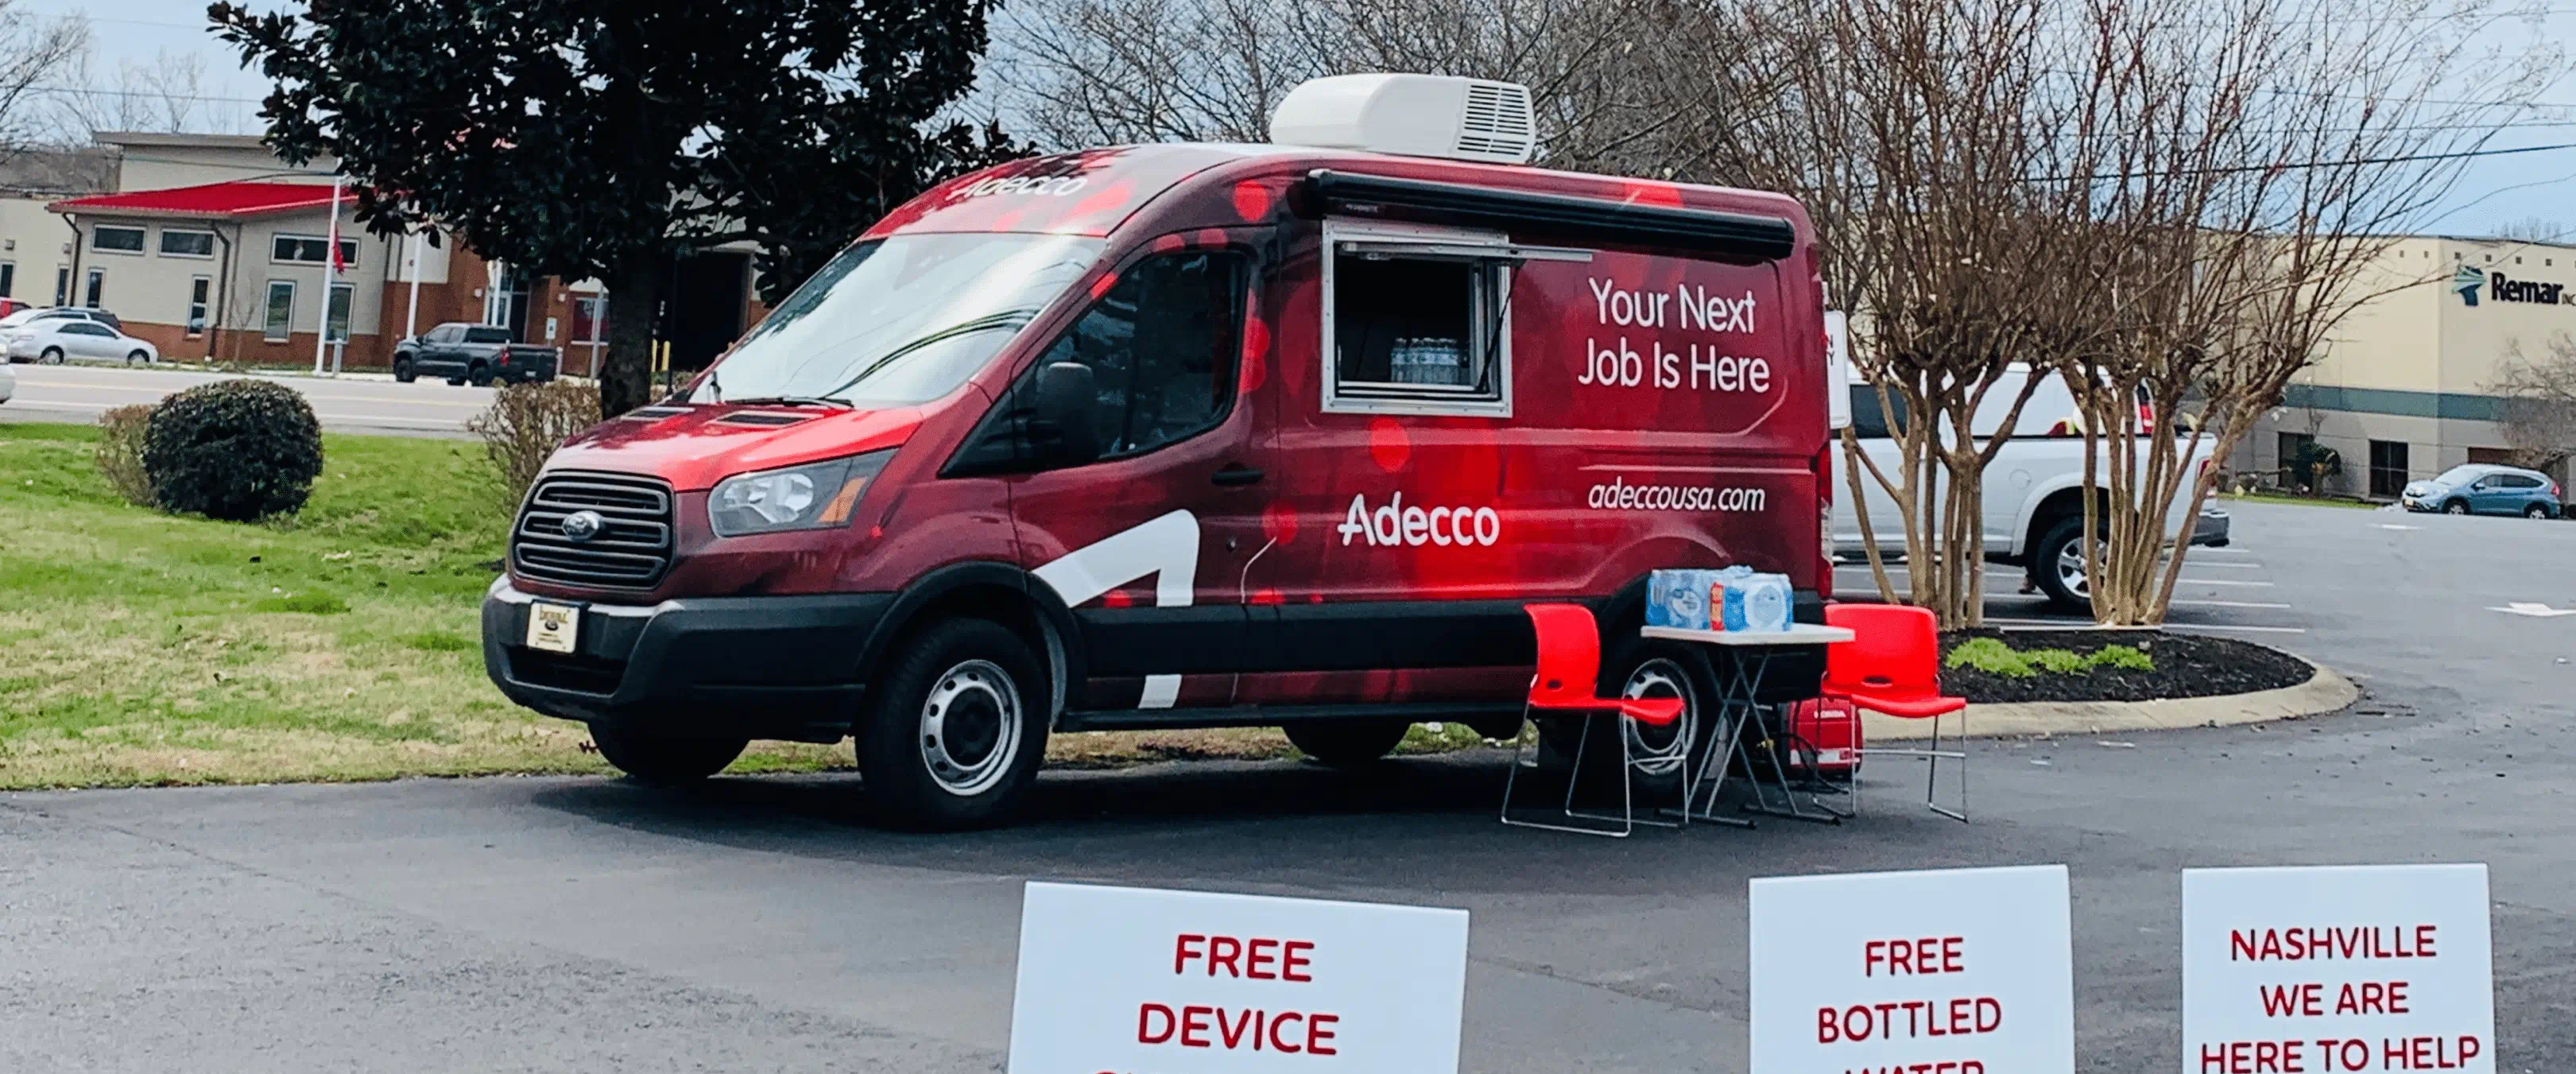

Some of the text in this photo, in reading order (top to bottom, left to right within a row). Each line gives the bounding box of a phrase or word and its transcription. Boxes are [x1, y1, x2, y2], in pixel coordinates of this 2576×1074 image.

[945, 168, 1088, 200] Adecco
[1588, 277, 1756, 334] Your Next
[2491, 272, 2563, 305] Remar
[1578, 336, 1770, 393] Job Is Here
[1589, 477, 1766, 512] adeccousa.com
[1338, 490, 1500, 547] Adecco
[1175, 934, 1315, 983] FREE
[1865, 936, 1964, 978] FREE
[2231, 925, 2437, 961] NASHVILLE
[1819, 997, 2001, 1044] BOTTLED
[2260, 982, 2410, 1017] WE ARE
[1137, 1003, 1339, 1056] DEVICE
[2201, 1036, 2481, 1074] HERE TO HELP
